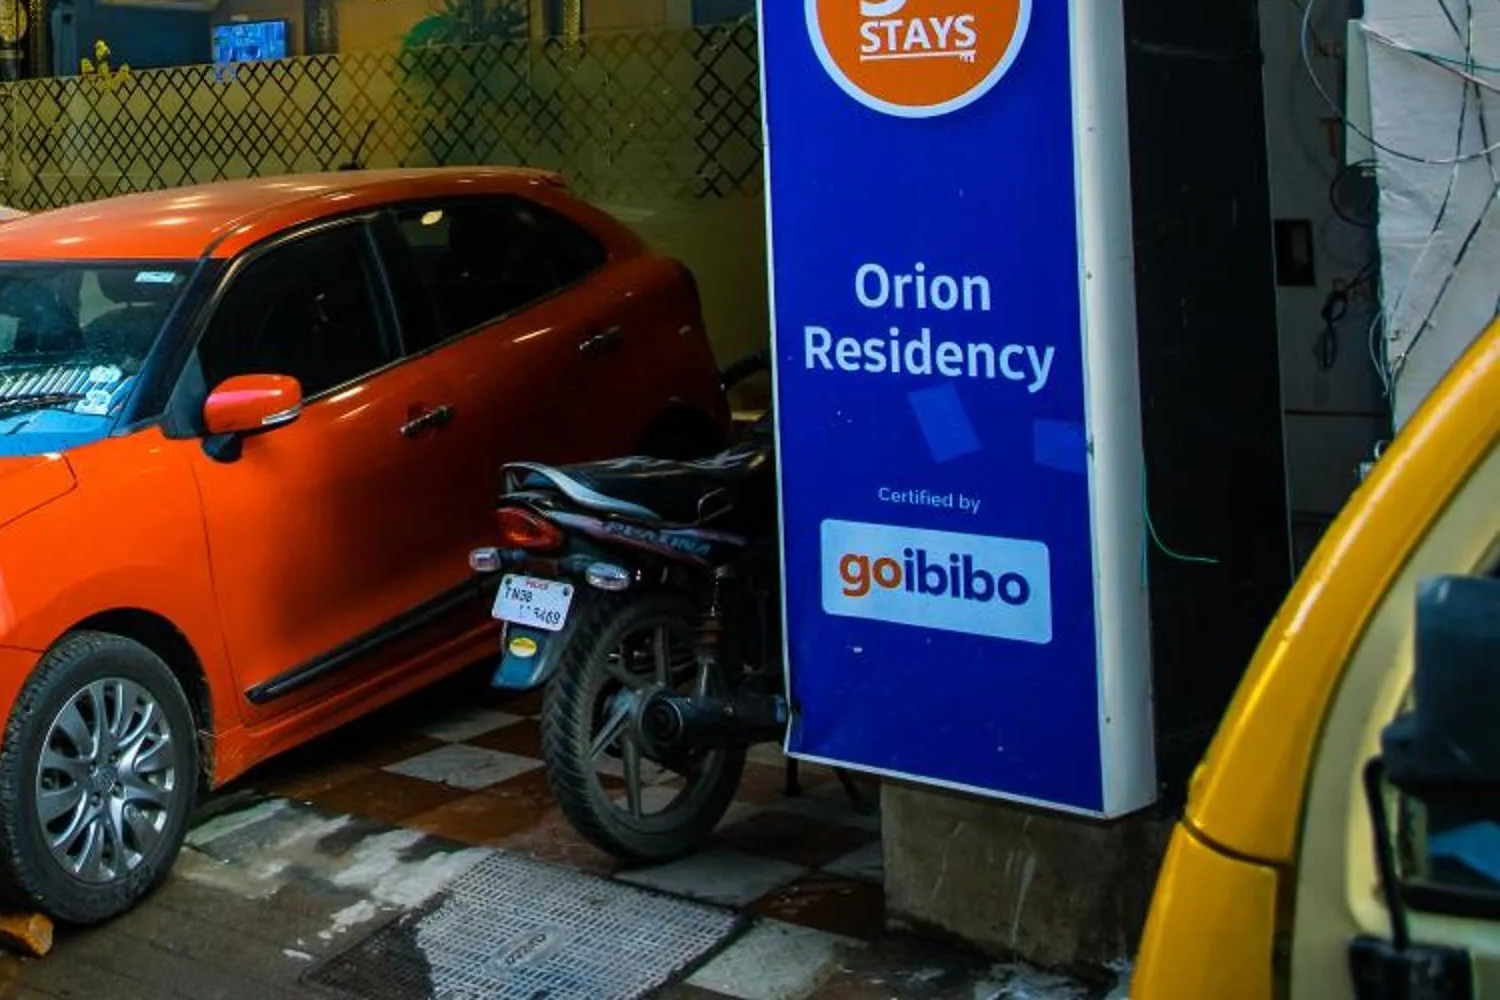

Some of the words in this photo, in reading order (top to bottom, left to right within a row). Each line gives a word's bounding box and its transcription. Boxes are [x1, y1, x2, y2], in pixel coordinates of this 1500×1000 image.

[858, 13, 978, 53] STAYS
[853, 260, 992, 312] Orion
[803, 324, 1056, 394] Residency
[877, 486, 954, 510] Certified
[958, 492, 981, 515] by
[838, 546, 1031, 606] goibibo
